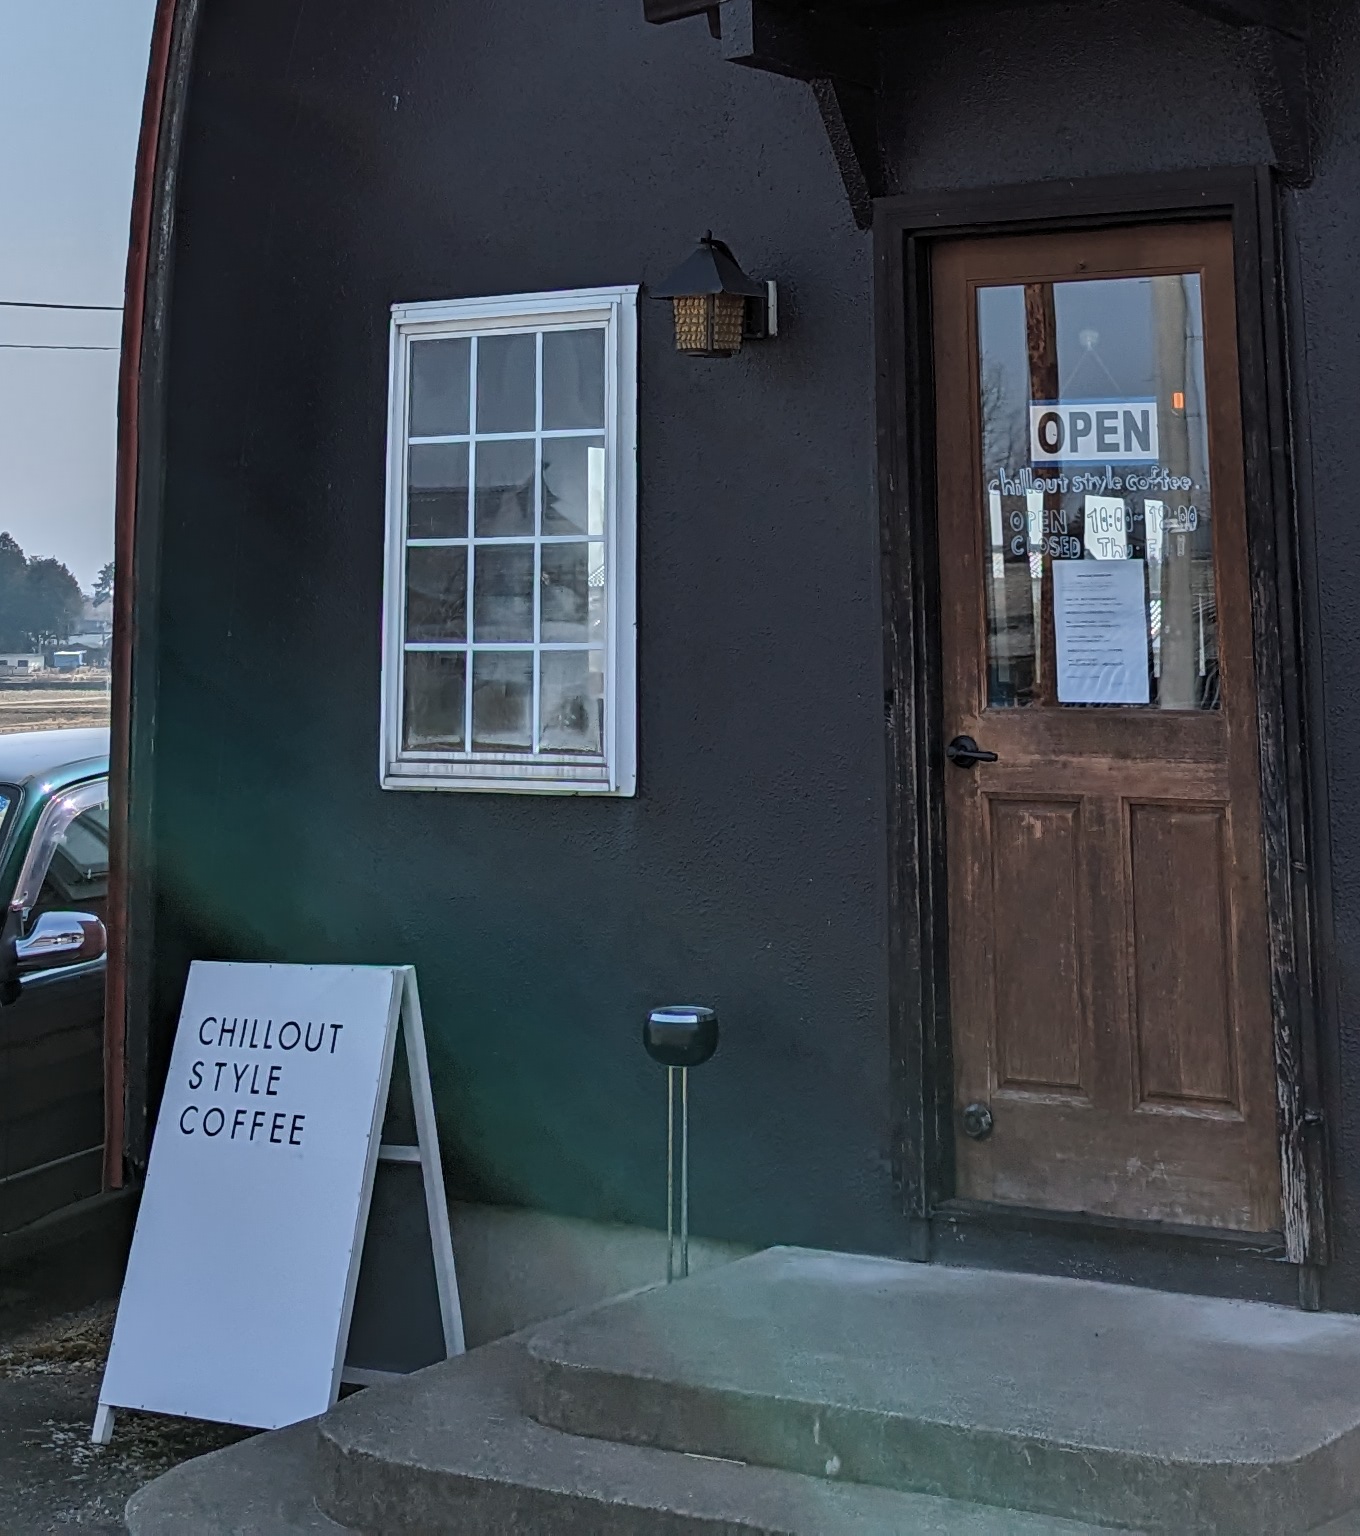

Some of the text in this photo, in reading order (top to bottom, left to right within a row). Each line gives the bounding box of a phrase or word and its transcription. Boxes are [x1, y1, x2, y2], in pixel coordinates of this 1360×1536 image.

[1037, 409, 1151, 454] OPEN
[988, 467, 1069, 496] chillout
[1072, 465, 1123, 495] style
[1009, 509, 1068, 535] OPEN
[1010, 535, 1081, 559] CLOSED
[198, 1016, 344, 1054] CHILLOUT
[188, 1061, 283, 1096] STYLE
[179, 1105, 306, 1146] COFFEE
